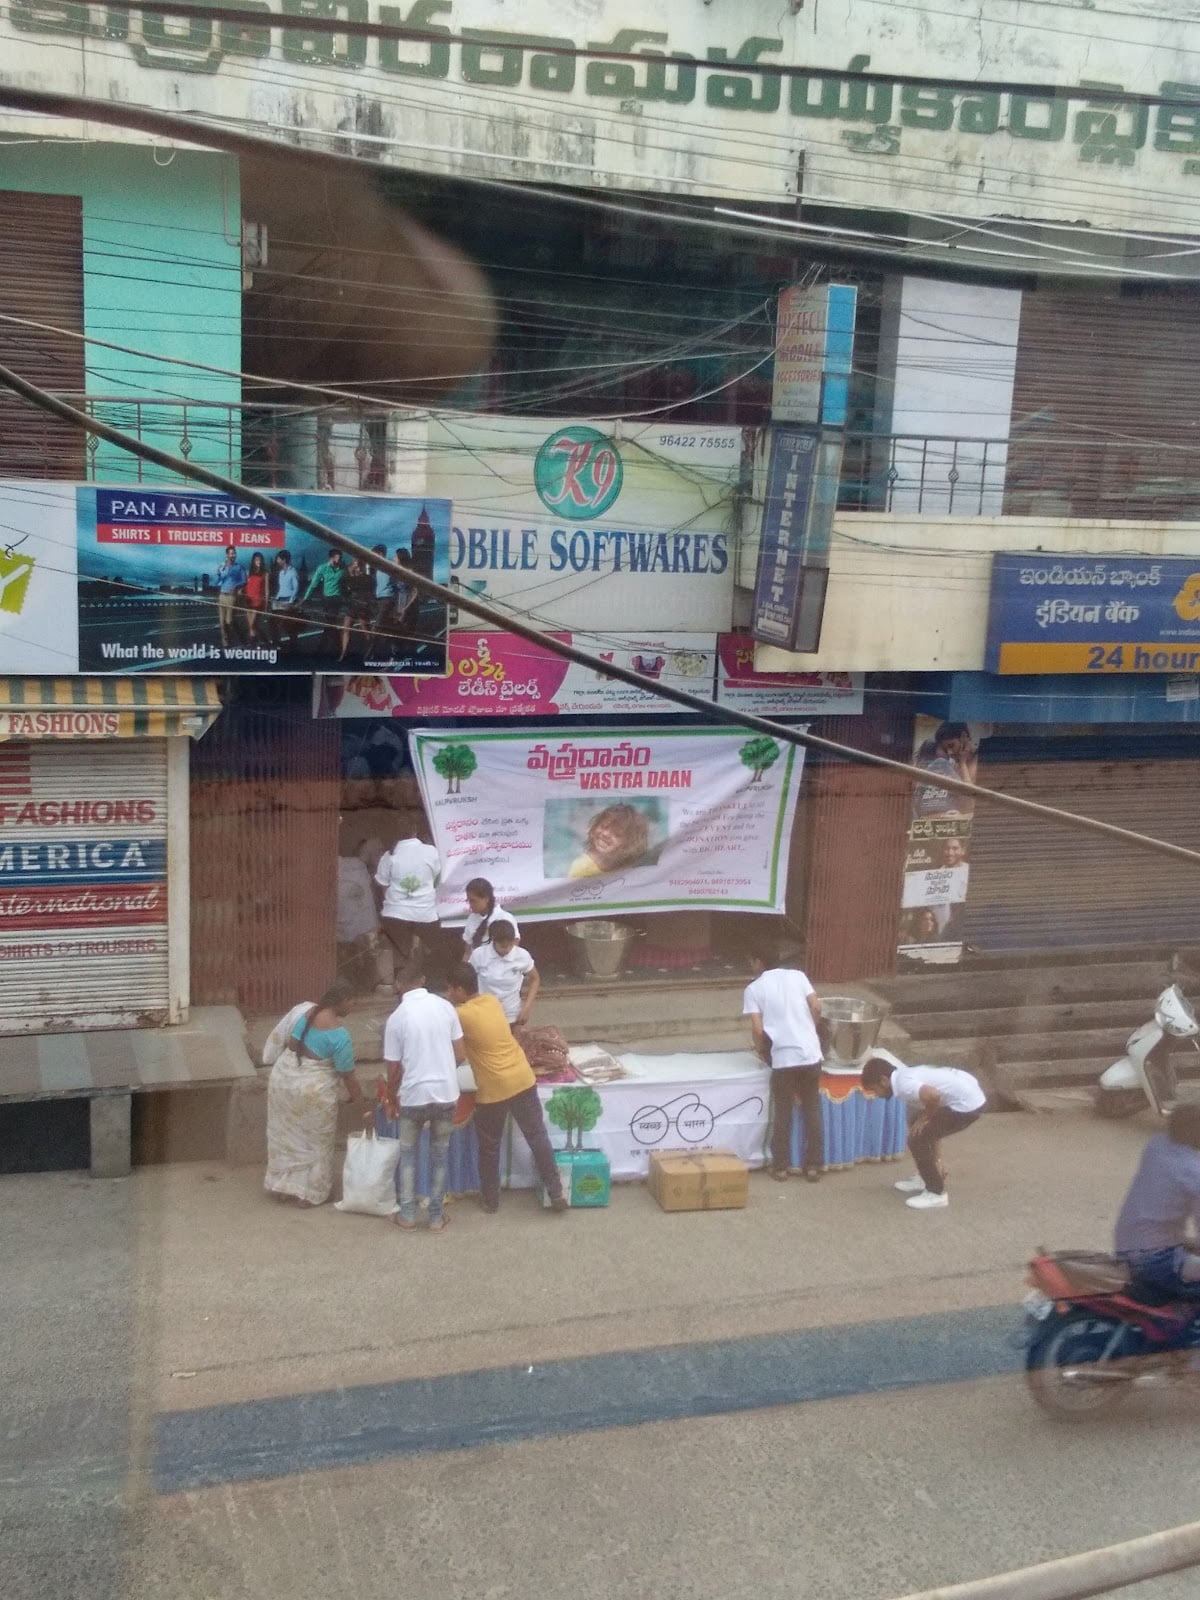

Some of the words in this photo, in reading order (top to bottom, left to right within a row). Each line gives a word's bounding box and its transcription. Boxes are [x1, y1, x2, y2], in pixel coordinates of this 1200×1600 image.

[659, 434, 695, 448] 96422
[699, 436, 736, 450] 75555
[542, 438, 617, 507] K9
[111, 500, 157, 517] PAN
[164, 502, 268, 522] AMERICA
[112, 528, 151, 541] SHIRTS
[168, 530, 224, 543] TROUSERS
[239, 532, 272, 545] JEANS
[771, 454, 799, 602] INTERNET
[549, 530, 730, 575] SOFTWARES
[1019, 565, 1107, 587] ఇండియన్
[1109, 565, 1163, 589] బ్యాంక్
[1035, 599, 1102, 628] इंडियन
[1104, 601, 1140, 624] बैंक
[101, 643, 140, 659] What
[142, 644, 165, 660] the
[168, 645, 207, 660] world
[209, 645, 221, 660] is
[224, 648, 278, 664] wearing
[1087, 646, 1124, 669] 24
[457, 677, 498, 697] లేడీస్
[8, 713, 119, 735] FASHIONS
[526, 741, 651, 780] వస్త్రదానం
[579, 771, 643, 790] VASTRA
[647, 769, 692, 788] DAAN
[0, 799, 157, 826] FASHIONS
[0, 942, 54, 958] SHIRTS
[75, 939, 157, 955] TROUSERS
[683, 1119, 706, 1129] भारत
